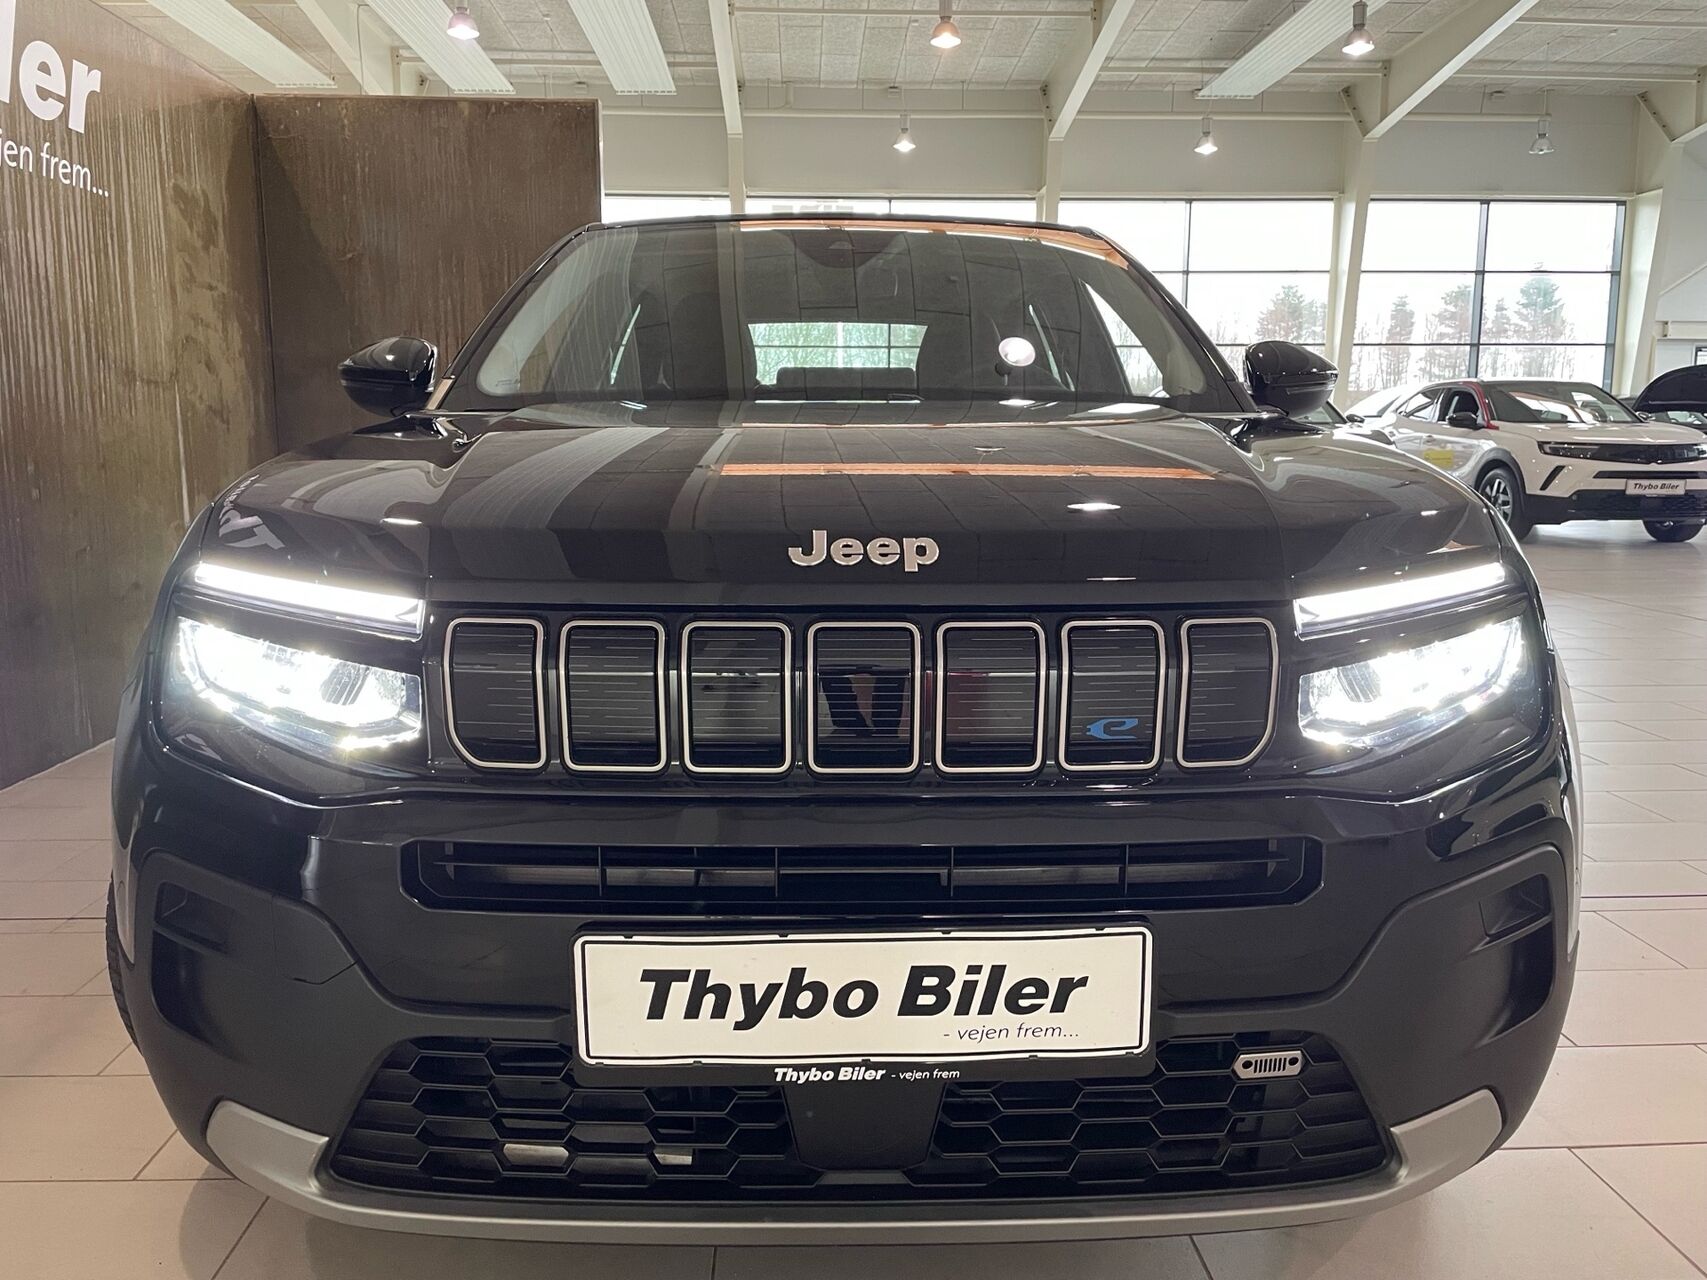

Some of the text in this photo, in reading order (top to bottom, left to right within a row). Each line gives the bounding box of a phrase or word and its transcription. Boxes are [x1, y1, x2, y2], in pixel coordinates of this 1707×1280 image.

[1634, 483, 1659, 491] Thybo
[788, 529, 940, 572] Jeep
[639, 964, 1089, 1031] Thybo Biler
[957, 1024, 1010, 1044] vejen
[1016, 1022, 1079, 1038] frem...
[774, 1067, 835, 1084] Thybo
[837, 1066, 886, 1081] Biler
[899, 1070, 930, 1082] vejen
[933, 1069, 960, 1079] frem
